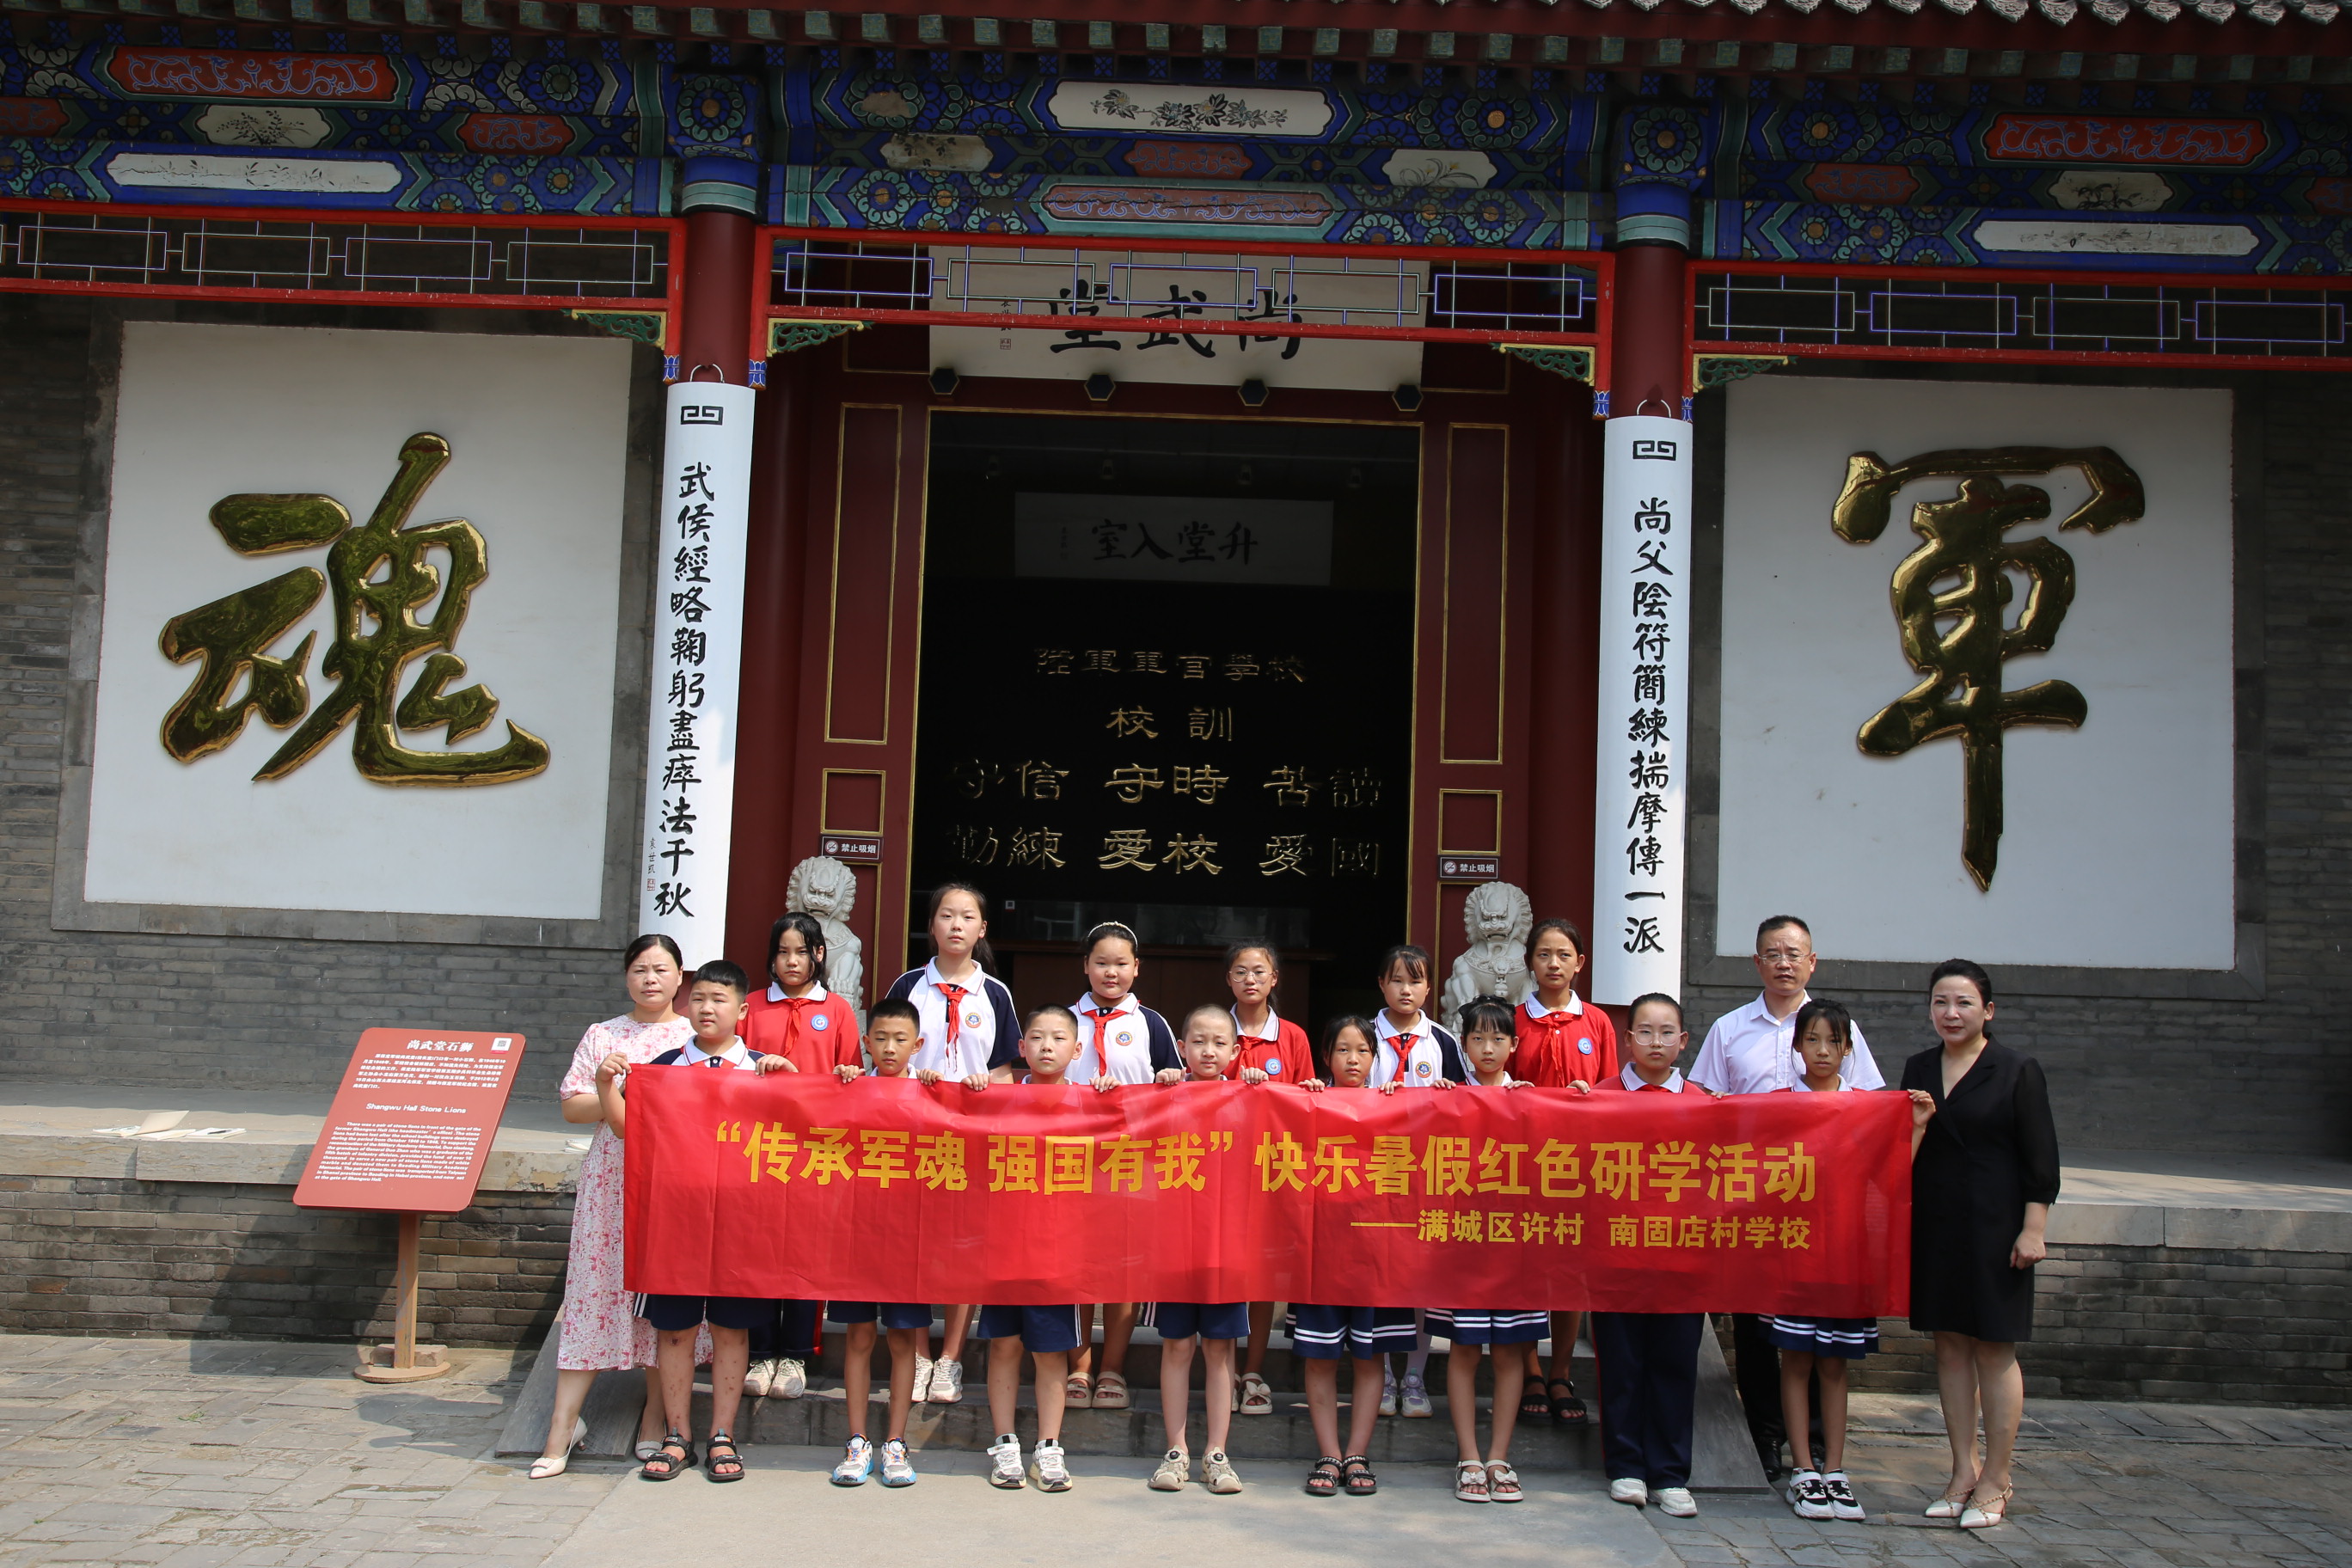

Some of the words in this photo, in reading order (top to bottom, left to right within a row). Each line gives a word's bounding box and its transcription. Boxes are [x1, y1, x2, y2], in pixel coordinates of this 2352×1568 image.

[158, 432, 551, 787] 魂
[1033, 646, 1308, 683] 陸軍軍官學校
[1831, 445, 2145, 894] 軍
[841, 843, 877, 854] 禁止吸烟
[1459, 863, 1495, 873] 禁止吸烟
[364, 1103, 401, 1112] Shangwu
[716, 1120, 969, 1191] “传承军魂
[988, 1130, 1234, 1195] 强国有我”
[1253, 1130, 1817, 1204] 快乐暑假红色研学活动
[1608, 1215, 1812, 1251] 南固店村学校
